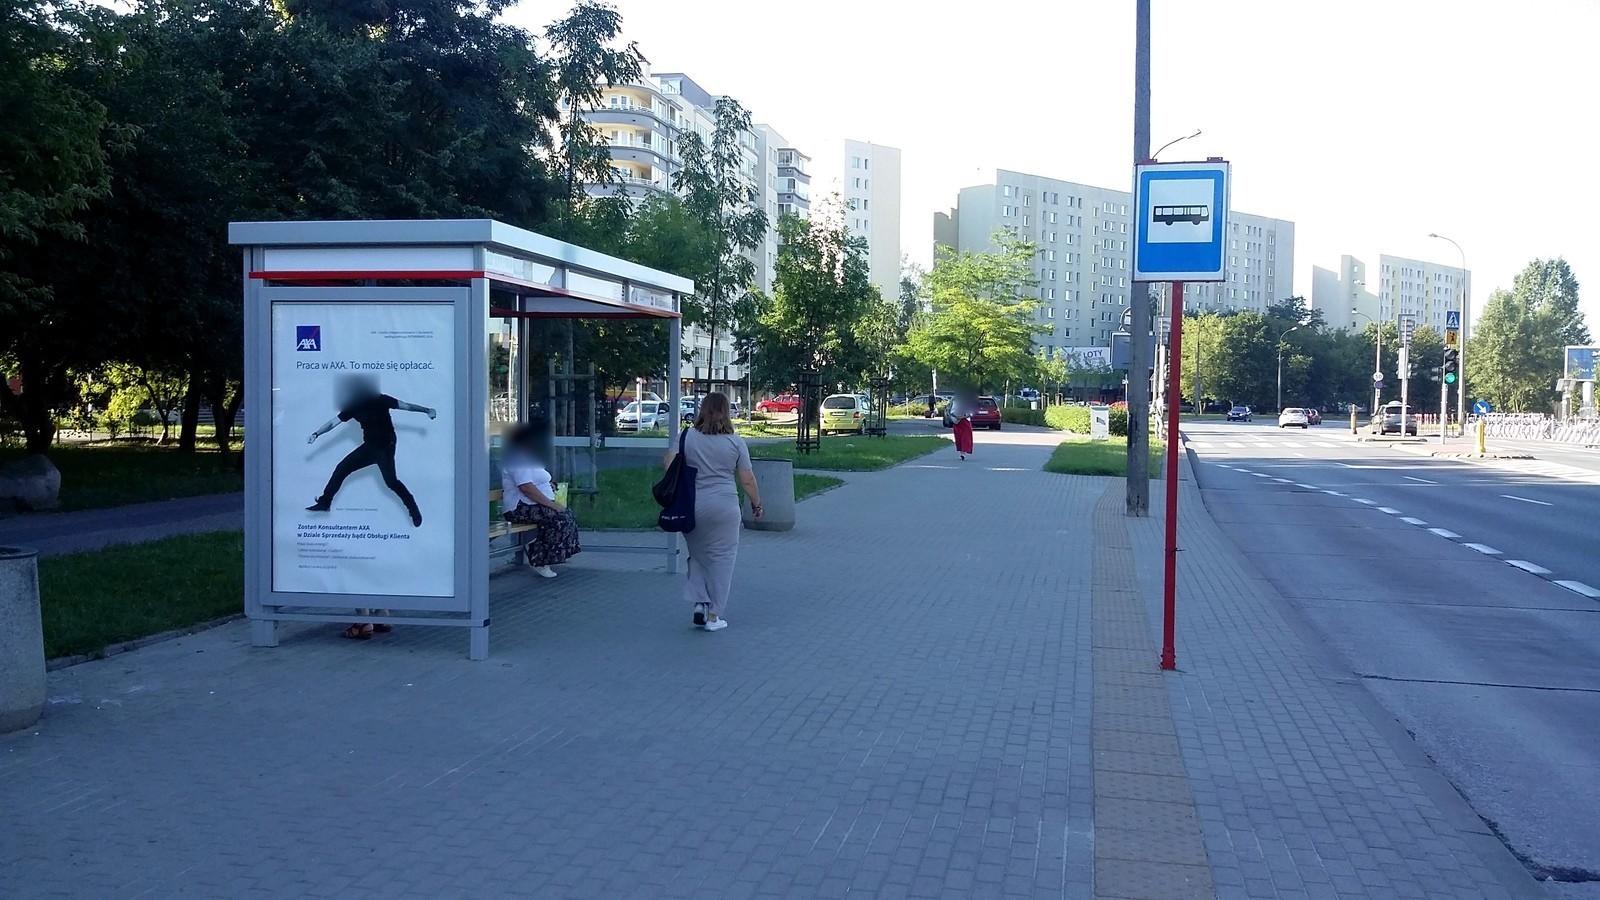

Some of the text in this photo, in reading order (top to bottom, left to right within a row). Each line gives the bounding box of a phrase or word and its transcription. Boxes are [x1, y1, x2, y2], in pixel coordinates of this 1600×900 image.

[296, 338, 317, 350] AXA
[296, 361, 320, 370] Praca
[330, 361, 348, 370] AXA.
[349, 361, 361, 370] To
[362, 361, 385, 370] może
[386, 361, 398, 372] się
[399, 361, 434, 372] opłacać.
[321, 531, 351, 539] Sprzedaży
[352, 532, 366, 540] bądź
[367, 532, 389, 540] Obsługi
